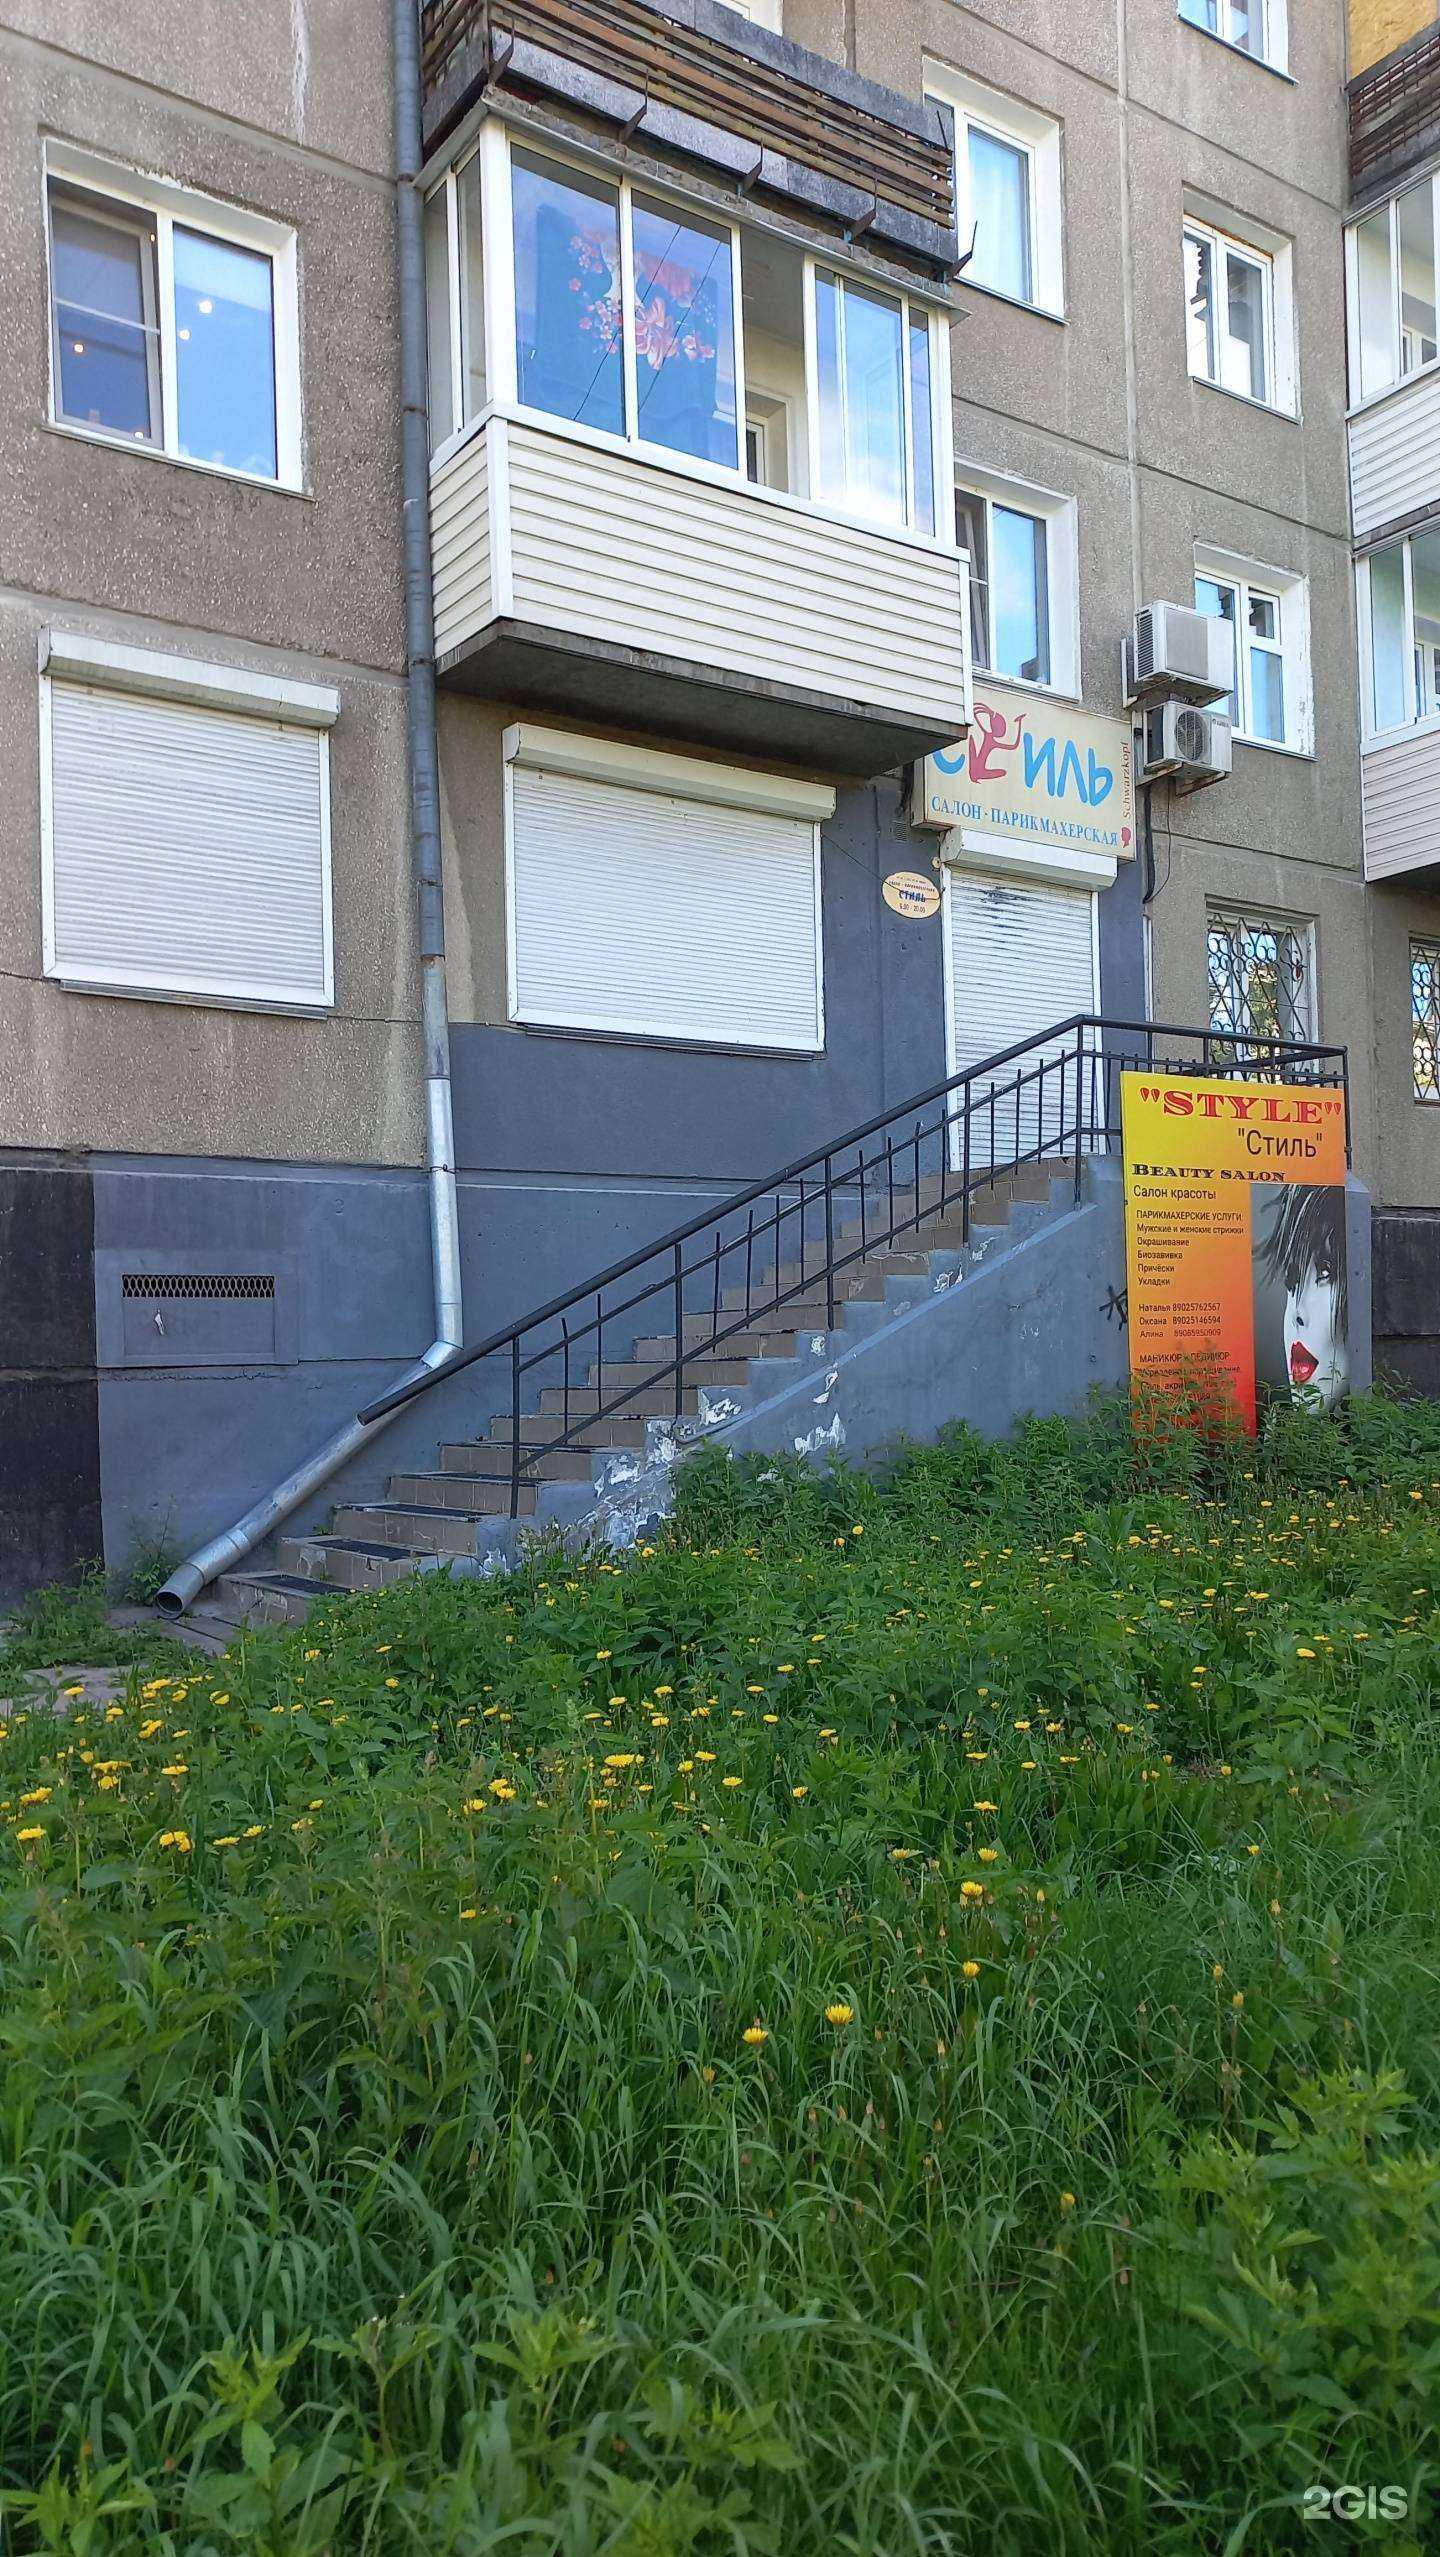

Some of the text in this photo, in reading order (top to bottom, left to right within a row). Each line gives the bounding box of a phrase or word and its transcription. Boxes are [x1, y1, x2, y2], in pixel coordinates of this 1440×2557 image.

[1120, 741, 1132, 819] Schwarzkopf
[1139, 1087, 1342, 1124] "STYLE"
[1237, 1127, 1323, 1158] "Стиль"
[1133, 1184, 1217, 1201] Салон красоты
[1136, 1209, 1242, 1222] ПАРИКМАХЕРСКИЕ УСЛУГИ
[1136, 1223, 1172, 1234] Мужские
[1212, 1227, 1244, 1236] стрижки
[1137, 1236, 1190, 1248] Окрашивание
[1137, 1249, 1183, 1260] Биозавивка
[1137, 1276, 1171, 1287] Укладки
[1138, 1303, 1171, 1312] Наталья
[1139, 1315, 1221, 1326] Оксана 89025146594
[1139, 1330, 1164, 1338] Алина
[1139, 1353, 1182, 1363] МАНИКЮР
